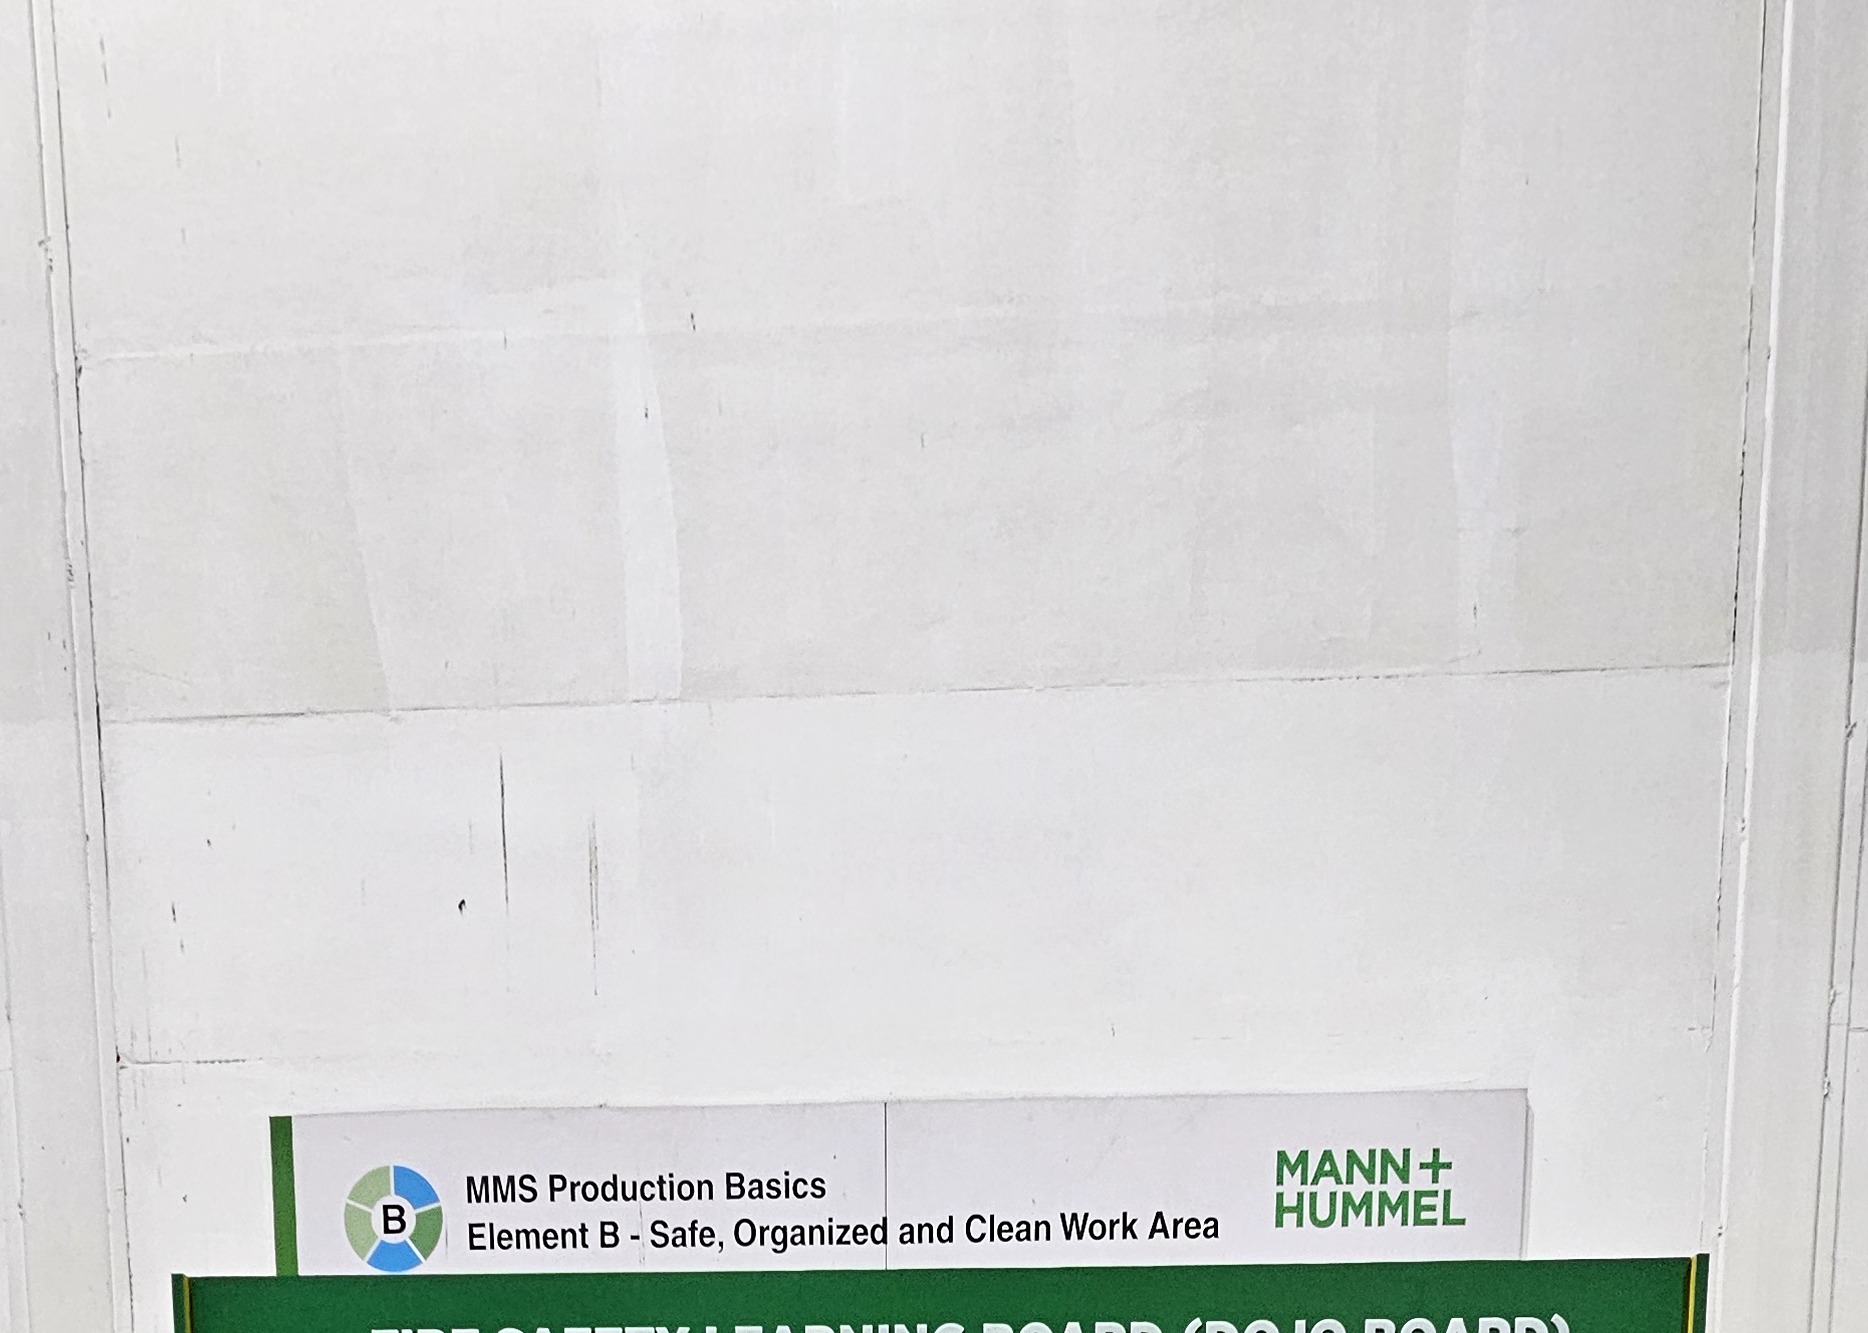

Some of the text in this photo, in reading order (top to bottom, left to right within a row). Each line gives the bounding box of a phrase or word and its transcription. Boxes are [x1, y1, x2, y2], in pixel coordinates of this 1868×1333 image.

[467, 1170, 826, 1203] MMS Production Basics
[382, 1205, 406, 1234] B
[1274, 1190, 1466, 1228] HUMMEL
[467, 1212, 1220, 1255] Element B Safe, Organized and Clean Work Area
